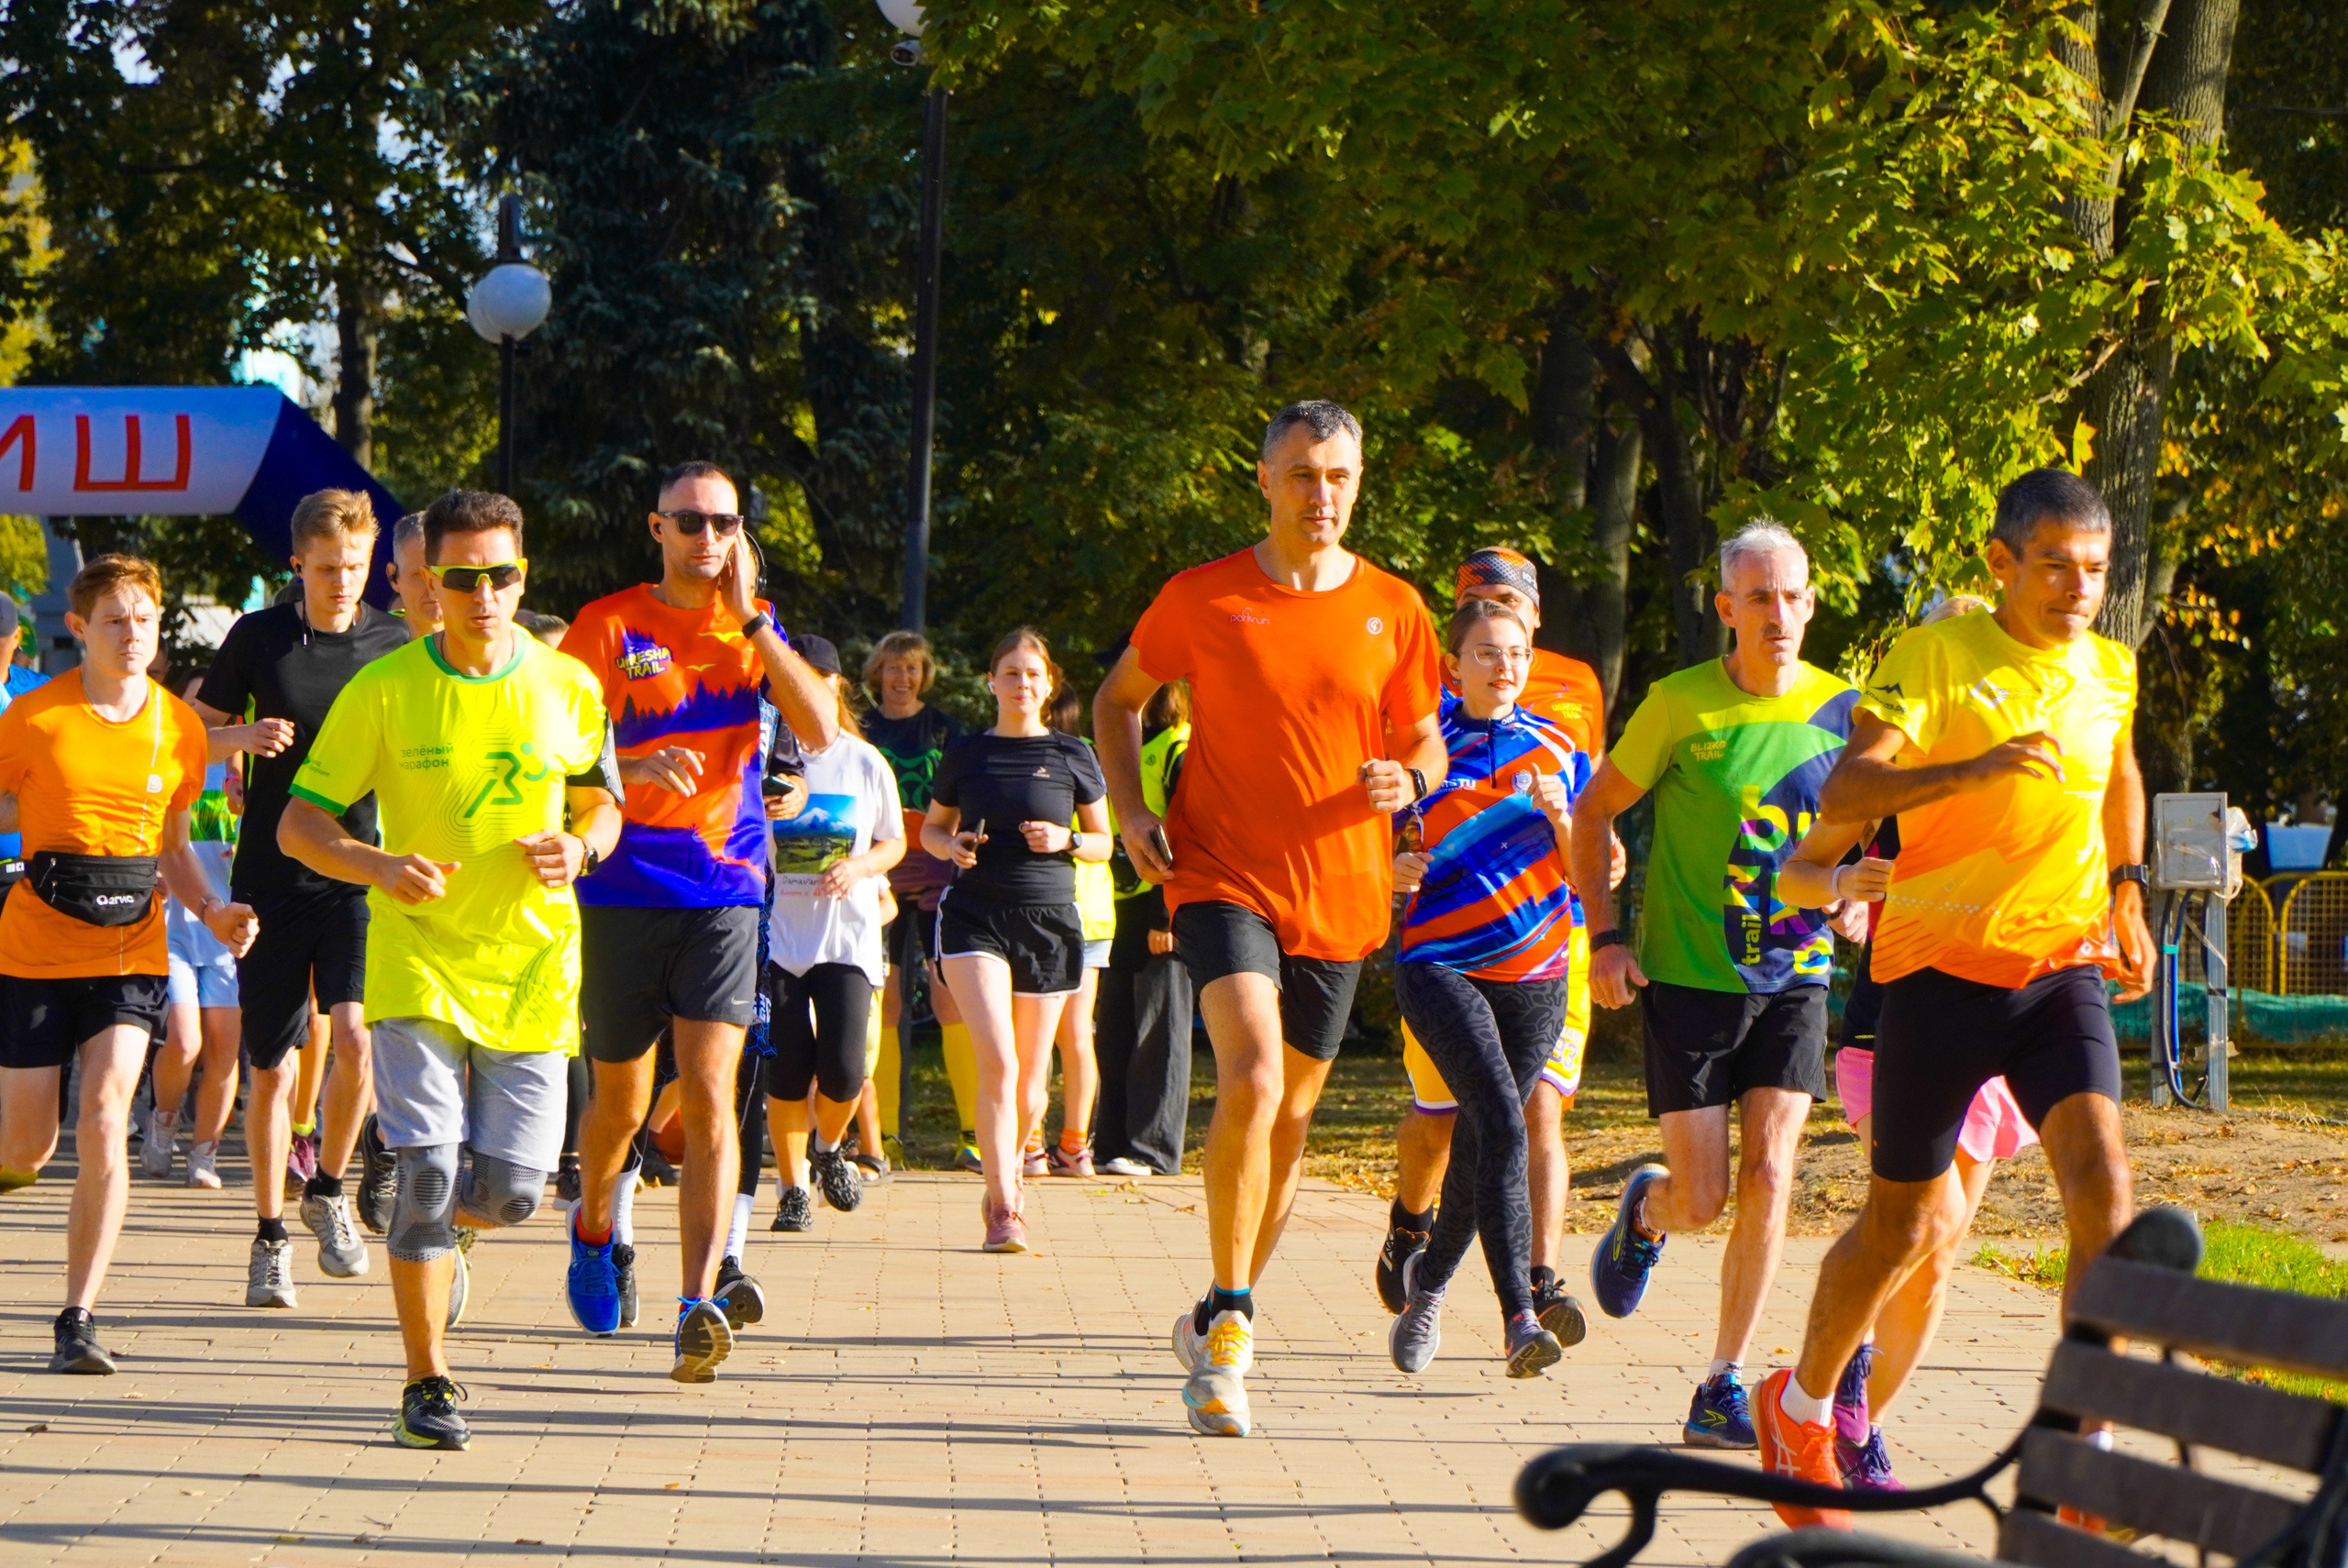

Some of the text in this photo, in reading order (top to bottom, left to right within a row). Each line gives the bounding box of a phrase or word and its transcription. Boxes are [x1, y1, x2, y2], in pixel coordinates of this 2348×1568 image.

[1230, 606, 1270, 624] parkrun
[626, 661, 666, 679] TRAIL
[401, 743, 454, 758] зелёный
[1693, 750, 1723, 762] TRAIL
[1741, 914, 1763, 966] trail
